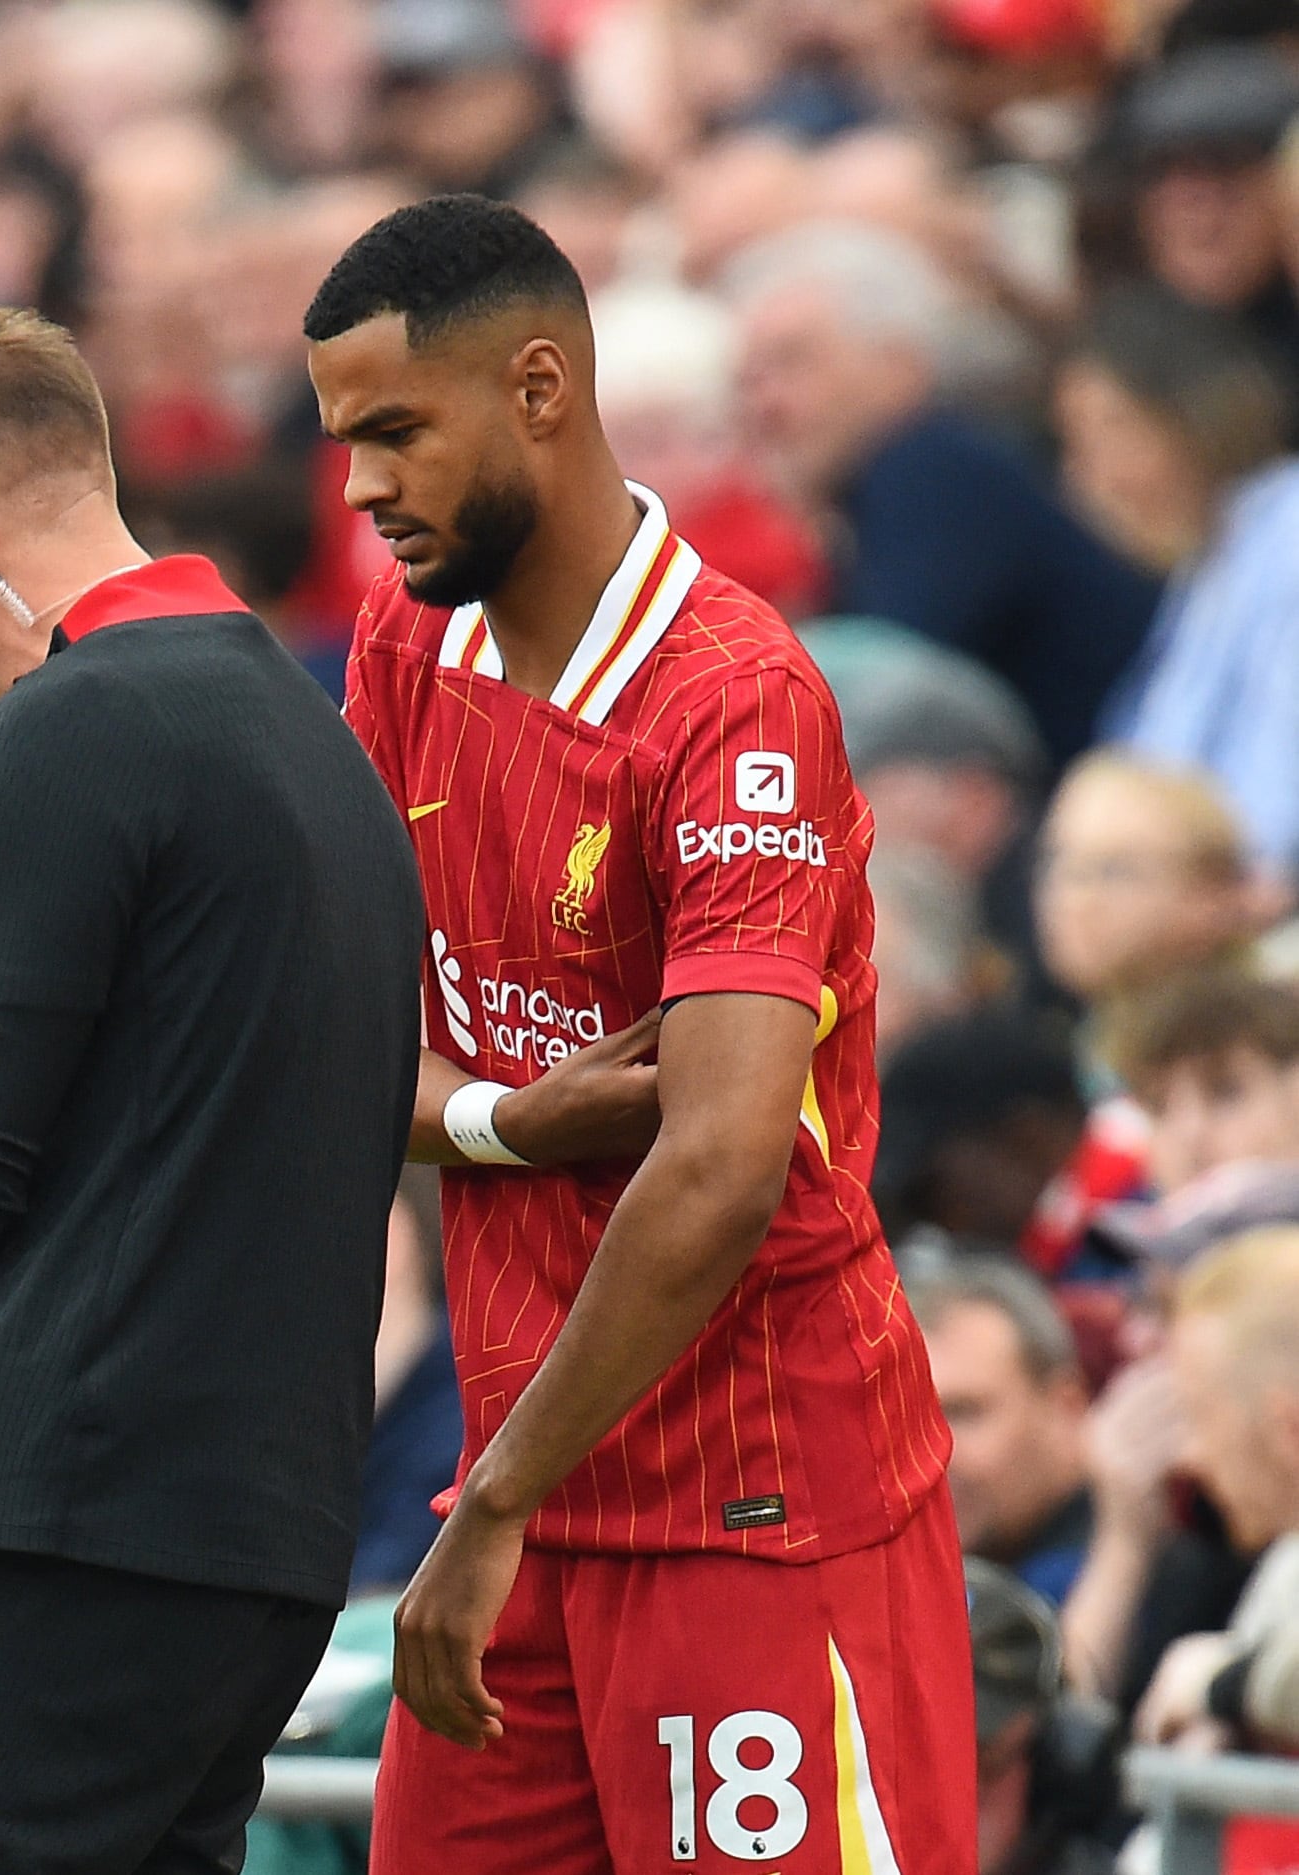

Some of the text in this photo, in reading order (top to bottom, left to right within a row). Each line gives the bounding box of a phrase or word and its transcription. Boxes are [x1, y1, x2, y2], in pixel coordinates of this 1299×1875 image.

[676, 820, 827, 865] Expedia
[478, 976, 605, 1042] andard
[658, 1710, 808, 1861] 18
